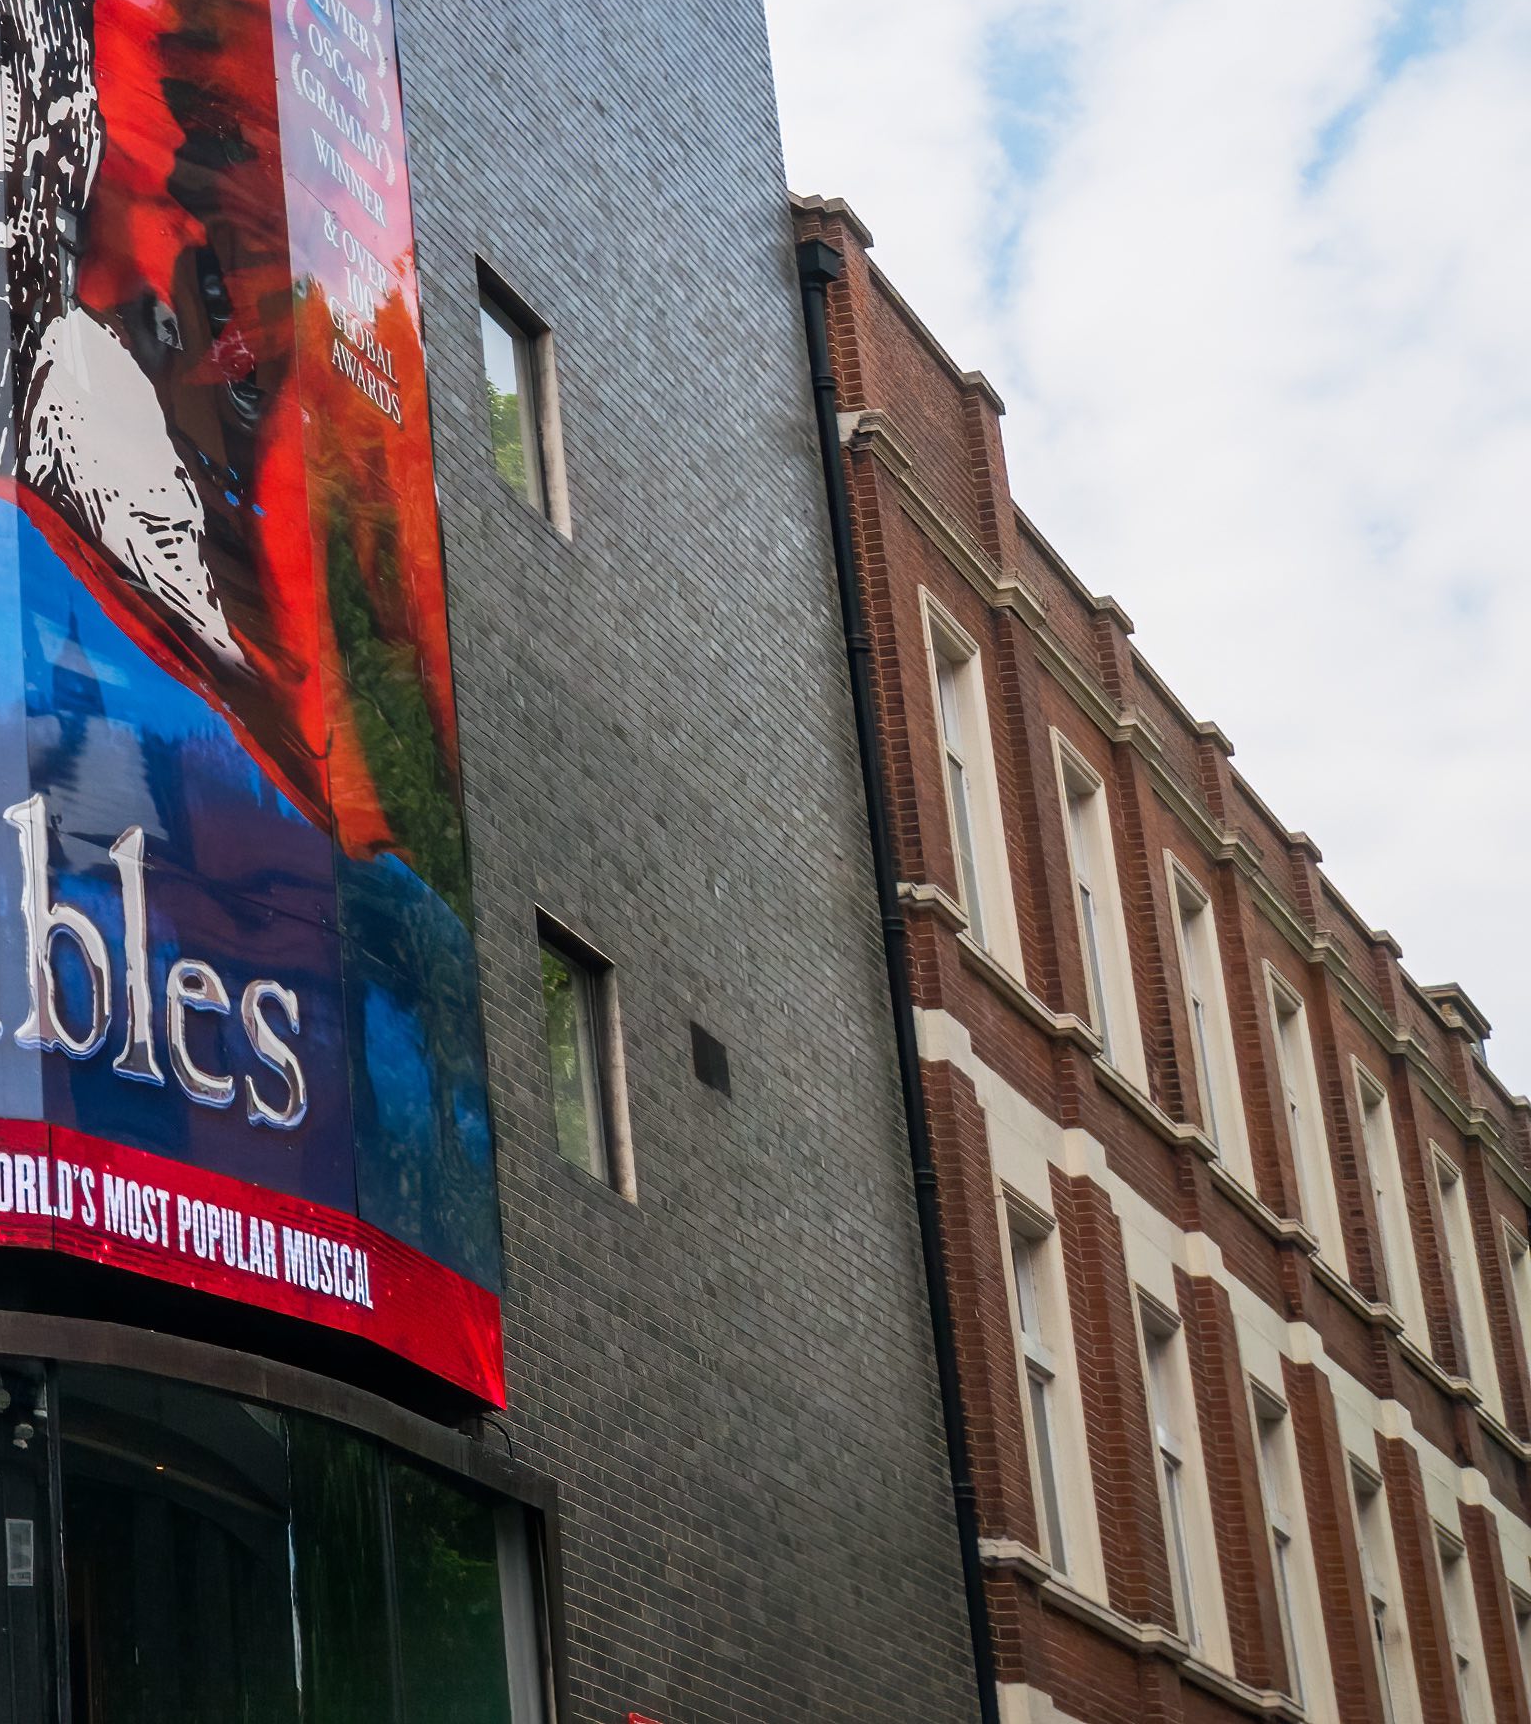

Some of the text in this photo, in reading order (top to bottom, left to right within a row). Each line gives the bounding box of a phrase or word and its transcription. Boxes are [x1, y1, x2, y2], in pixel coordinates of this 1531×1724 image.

[308, 23, 369, 109] OSCAR
[301, 68, 383, 172] GRAMMY
[311, 128, 386, 228] WINNER
[323, 210, 390, 299] & OVER
[344, 267, 376, 323] 100
[329, 295, 398, 383] GLOBAL
[332, 338, 402, 424] AWARDS
[103, 1176, 170, 1246] MOST
[178, 1196, 278, 1277] POPULAR
[283, 1226, 375, 1310] MUSICAL
